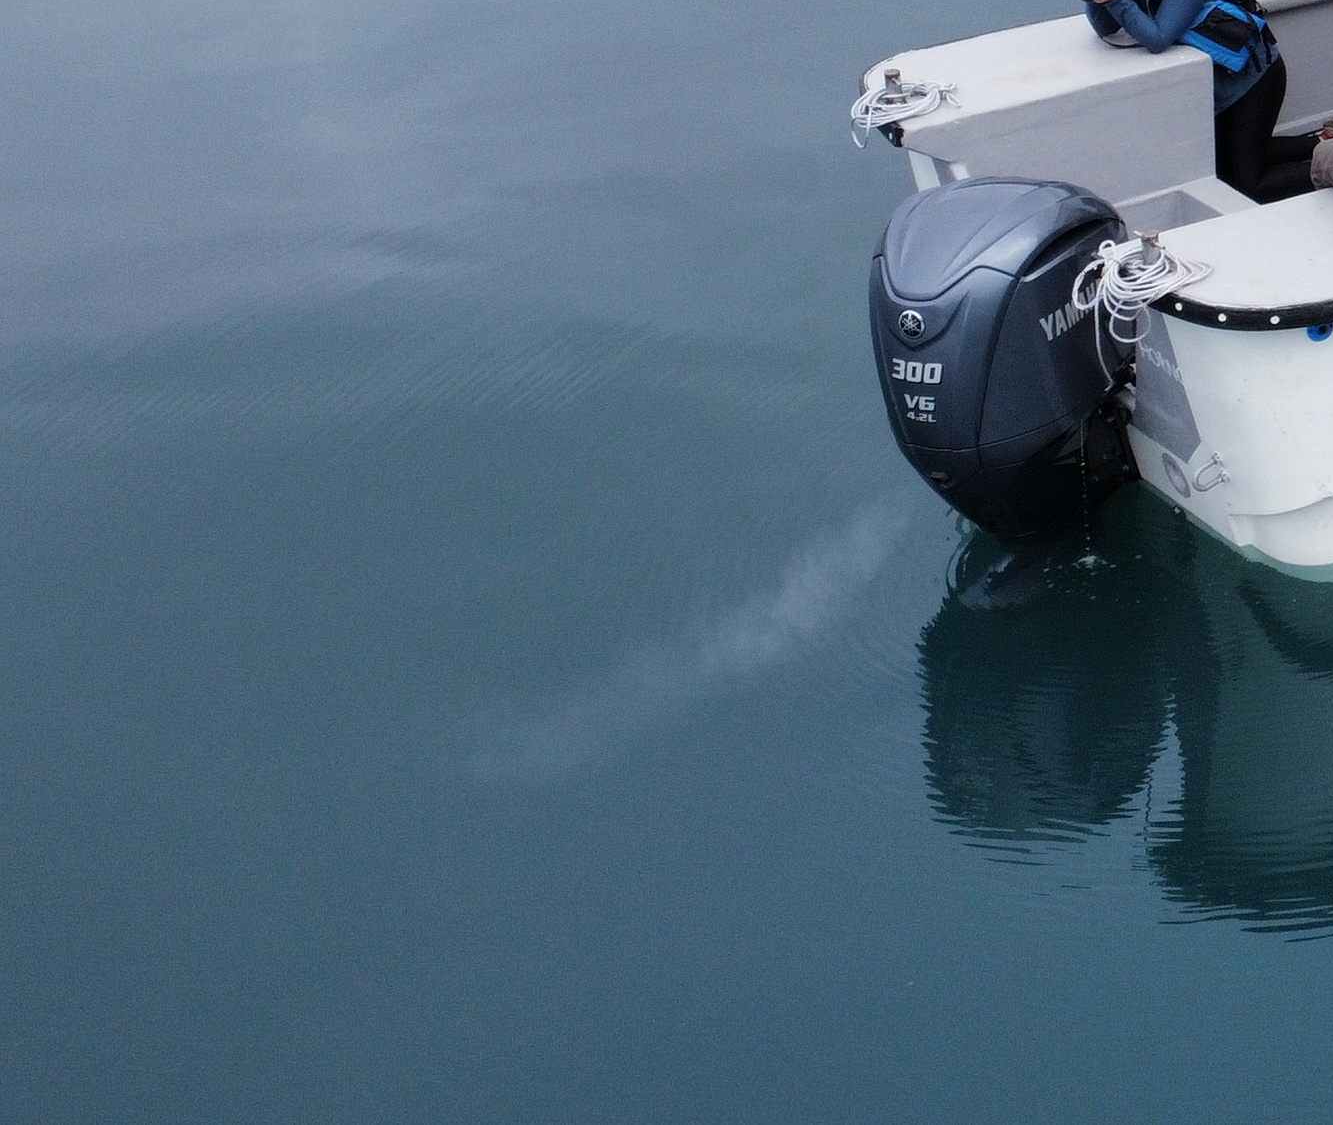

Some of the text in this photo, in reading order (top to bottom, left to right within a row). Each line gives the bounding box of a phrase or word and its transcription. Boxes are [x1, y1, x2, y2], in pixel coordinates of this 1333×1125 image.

[891, 358, 942, 384] 300
[904, 393, 935, 411] V6
[906, 411, 937, 423] 4.2L
